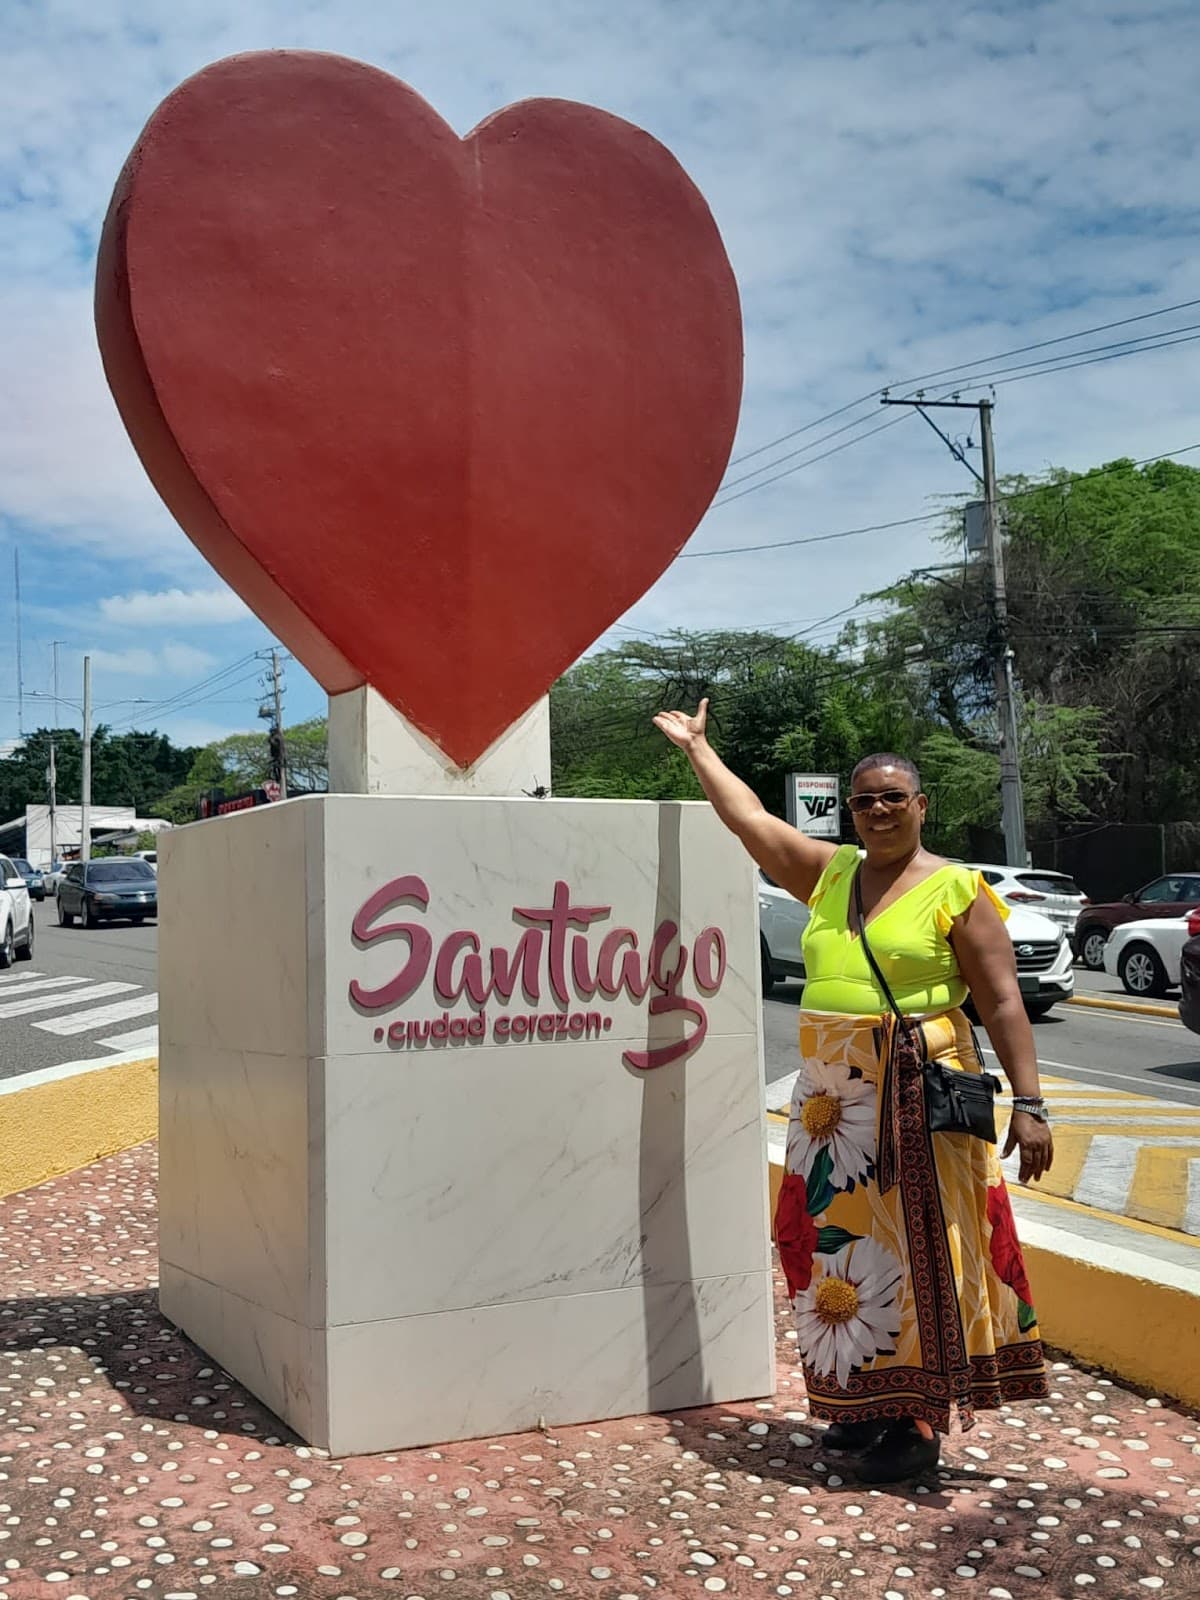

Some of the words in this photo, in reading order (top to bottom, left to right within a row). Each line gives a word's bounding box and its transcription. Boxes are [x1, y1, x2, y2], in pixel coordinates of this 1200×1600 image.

[798, 781, 837, 789] DISPONIBLE
[799, 795, 837, 817] VIP
[349, 875, 727, 1070] Santiago
